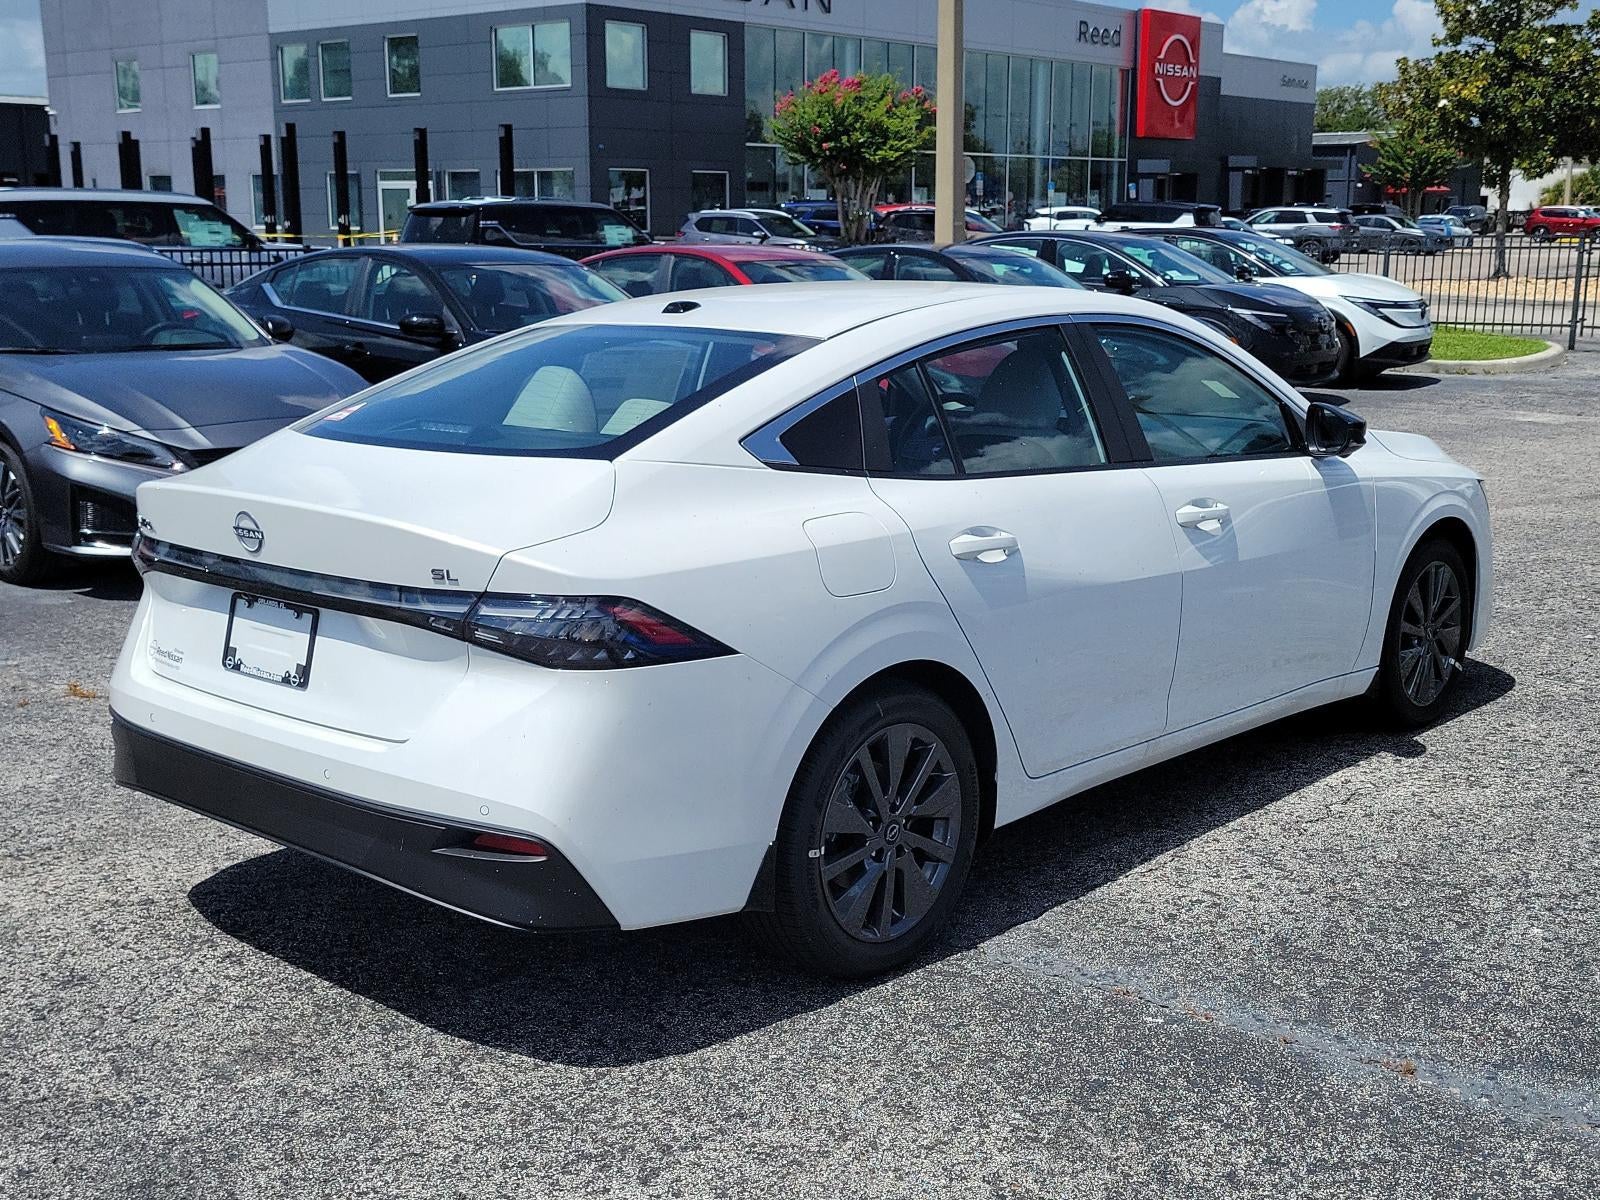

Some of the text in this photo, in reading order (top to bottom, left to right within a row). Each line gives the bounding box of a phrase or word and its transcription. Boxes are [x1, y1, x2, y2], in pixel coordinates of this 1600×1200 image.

[1077, 19, 1122, 48] Reed
[1154, 62, 1198, 79] NISSAN
[431, 568, 459, 582] SL
